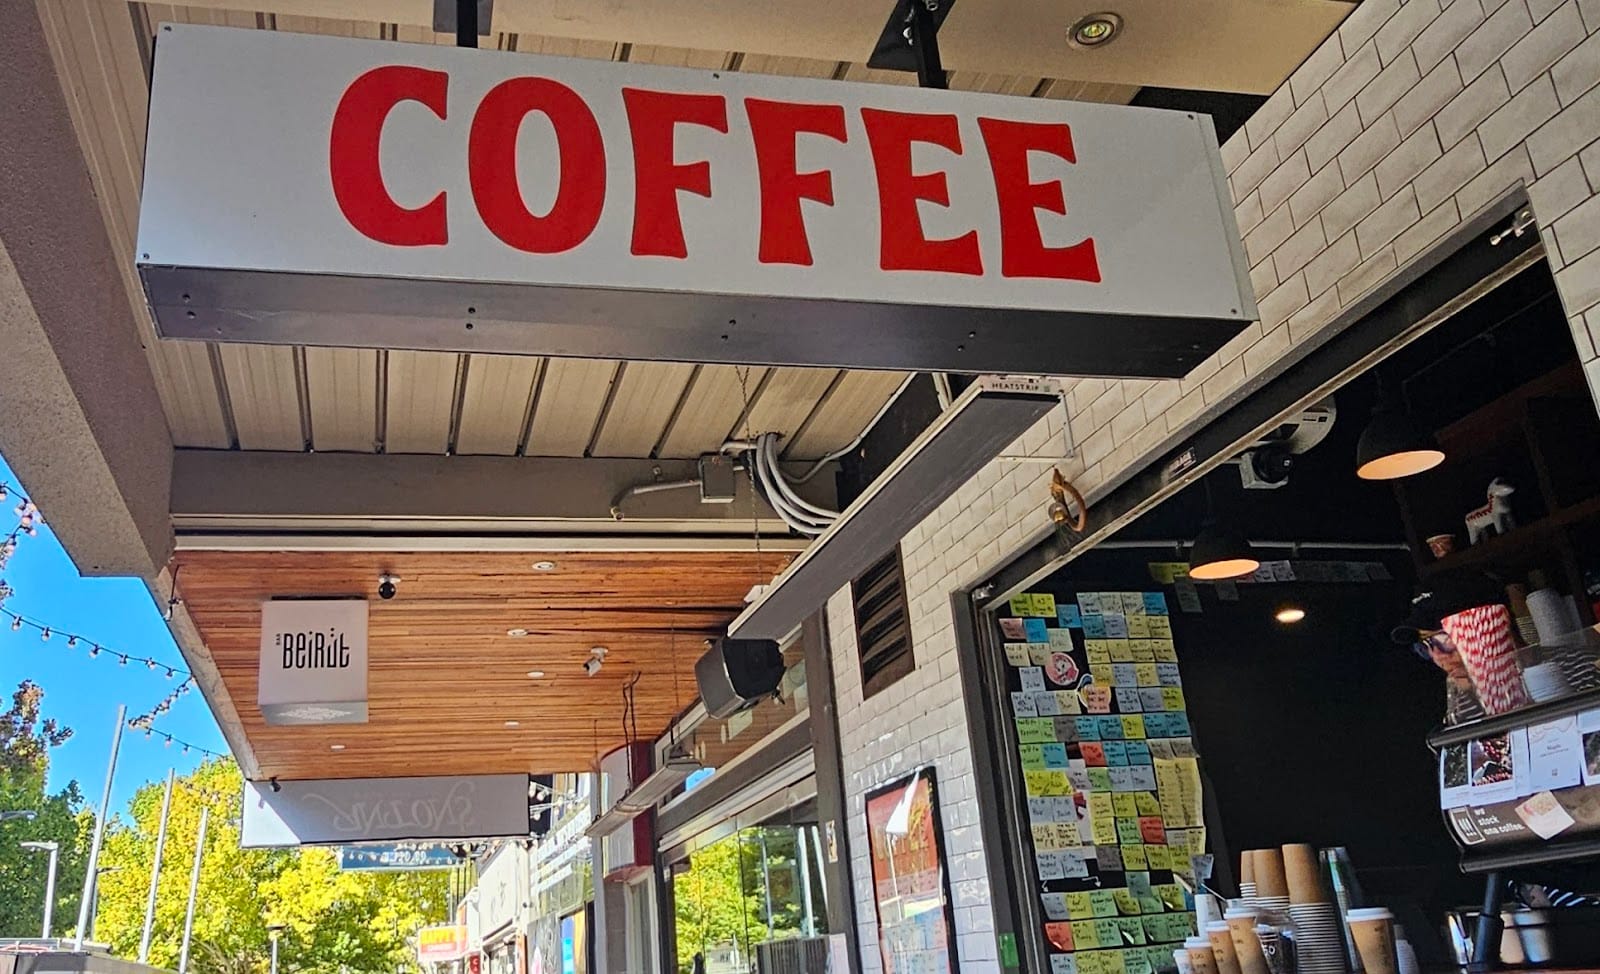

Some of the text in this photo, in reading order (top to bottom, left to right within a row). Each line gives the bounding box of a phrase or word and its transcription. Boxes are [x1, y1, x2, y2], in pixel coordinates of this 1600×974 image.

[330, 65, 1102, 283] COFFEE
[992, 383, 1039, 391] HEATSTRIP
[1478, 814, 1500, 826] stock
